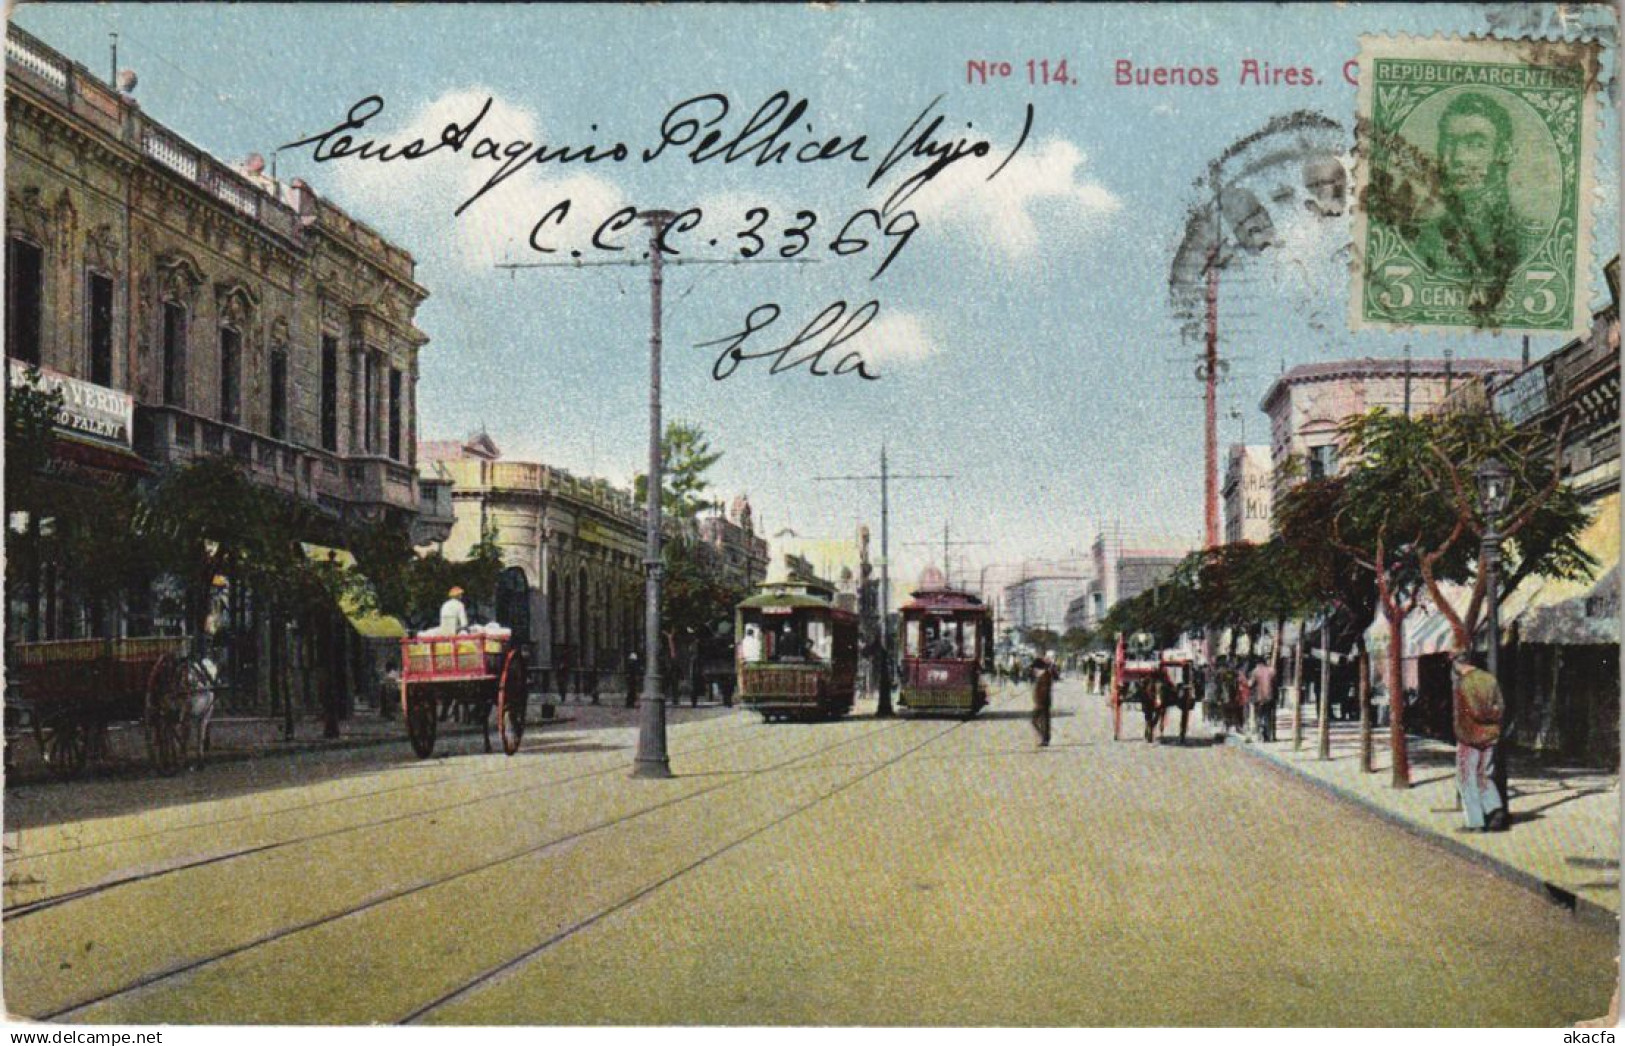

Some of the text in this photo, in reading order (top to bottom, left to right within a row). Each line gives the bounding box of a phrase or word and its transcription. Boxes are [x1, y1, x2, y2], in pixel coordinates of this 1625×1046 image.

[737, 206, 920, 281] 3369
[1379, 265, 1415, 308] 3
[1523, 270, 1558, 314] 3
[693, 299, 884, 381] Ella
[70, 381, 128, 418] VERDI
